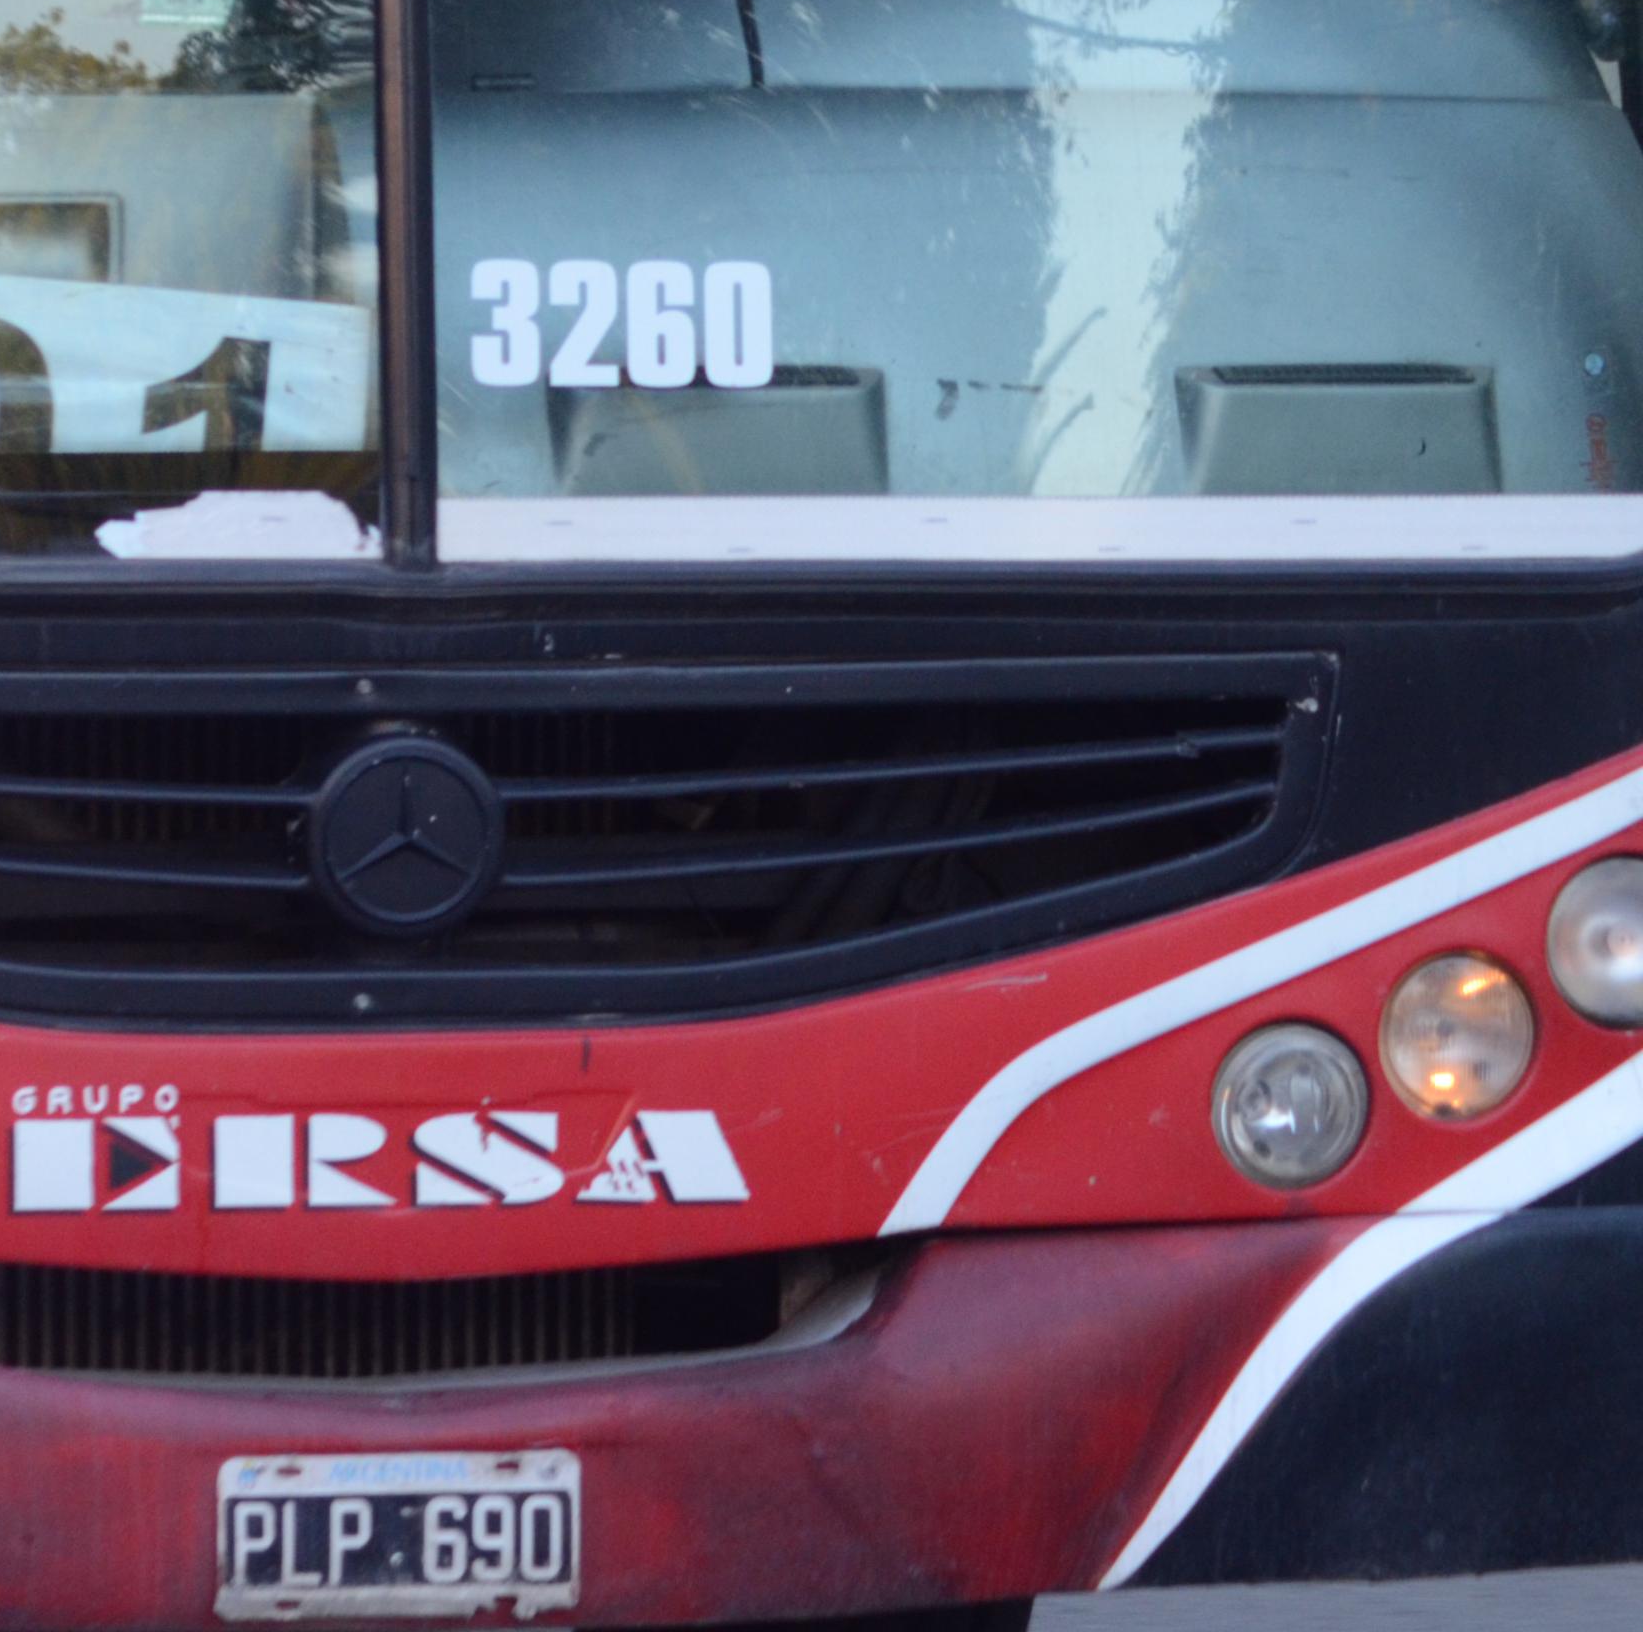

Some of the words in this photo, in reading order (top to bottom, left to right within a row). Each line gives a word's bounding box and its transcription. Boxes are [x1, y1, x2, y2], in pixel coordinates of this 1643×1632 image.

[470, 258, 775, 389] 3260
[12, 1085, 180, 1115] GRUPO
[233, 1500, 373, 1586] PLP
[422, 1494, 565, 1585] 690
